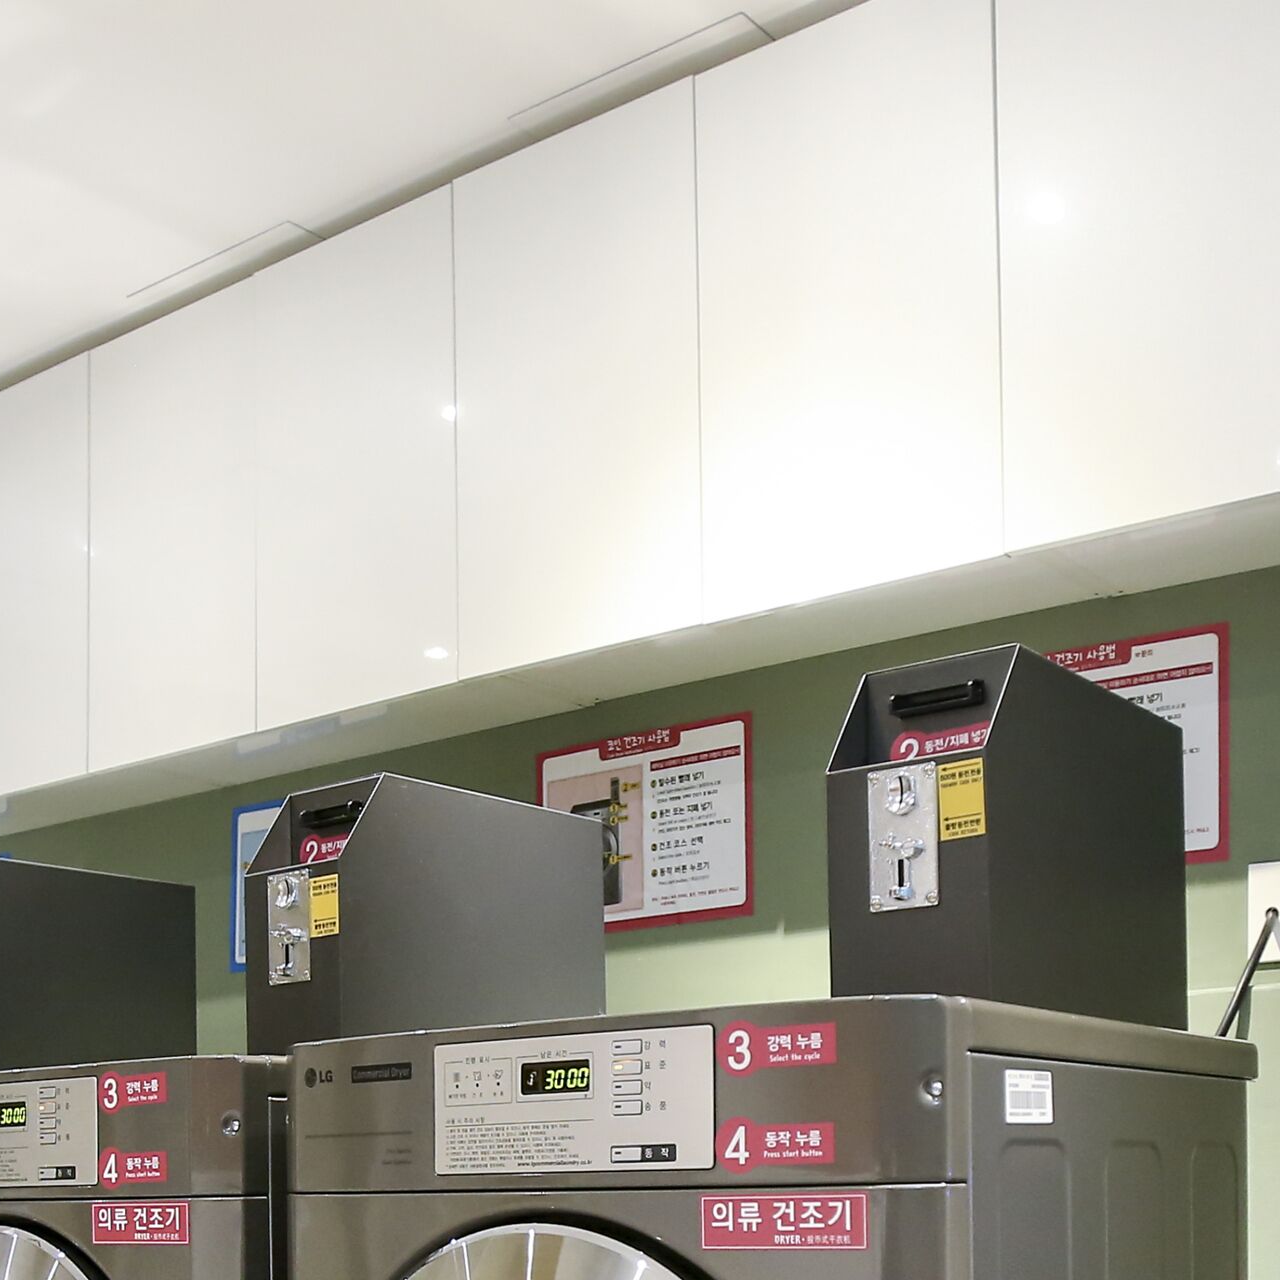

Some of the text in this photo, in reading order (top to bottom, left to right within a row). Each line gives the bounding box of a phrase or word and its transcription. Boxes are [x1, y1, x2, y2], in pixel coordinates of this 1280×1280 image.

[1055, 652, 1083, 666] 건조기
[1086, 643, 1116, 661] 사용법
[624, 736, 645, 749] 건조기
[648, 729, 670, 744] 사용법
[901, 738, 919, 761] 2
[925, 734, 969, 753] 동전/지폐
[306, 839, 347, 863] 2 동전/지
[727, 1030, 823, 1070] 3 강력 누름
[770, 1054, 788, 1062] Select
[318, 1070, 334, 1083] LG
[103, 1078, 158, 1109] 3 강력 누름
[725, 1125, 822, 1165] 4 동작 누름
[783, 1150, 798, 1158] start
[801, 1149, 822, 1157] button
[103, 1153, 159, 1183] 4 동작 누름
[98, 1207, 180, 1231] 의류 건조기
[712, 1200, 852, 1232] 의류 건조기
